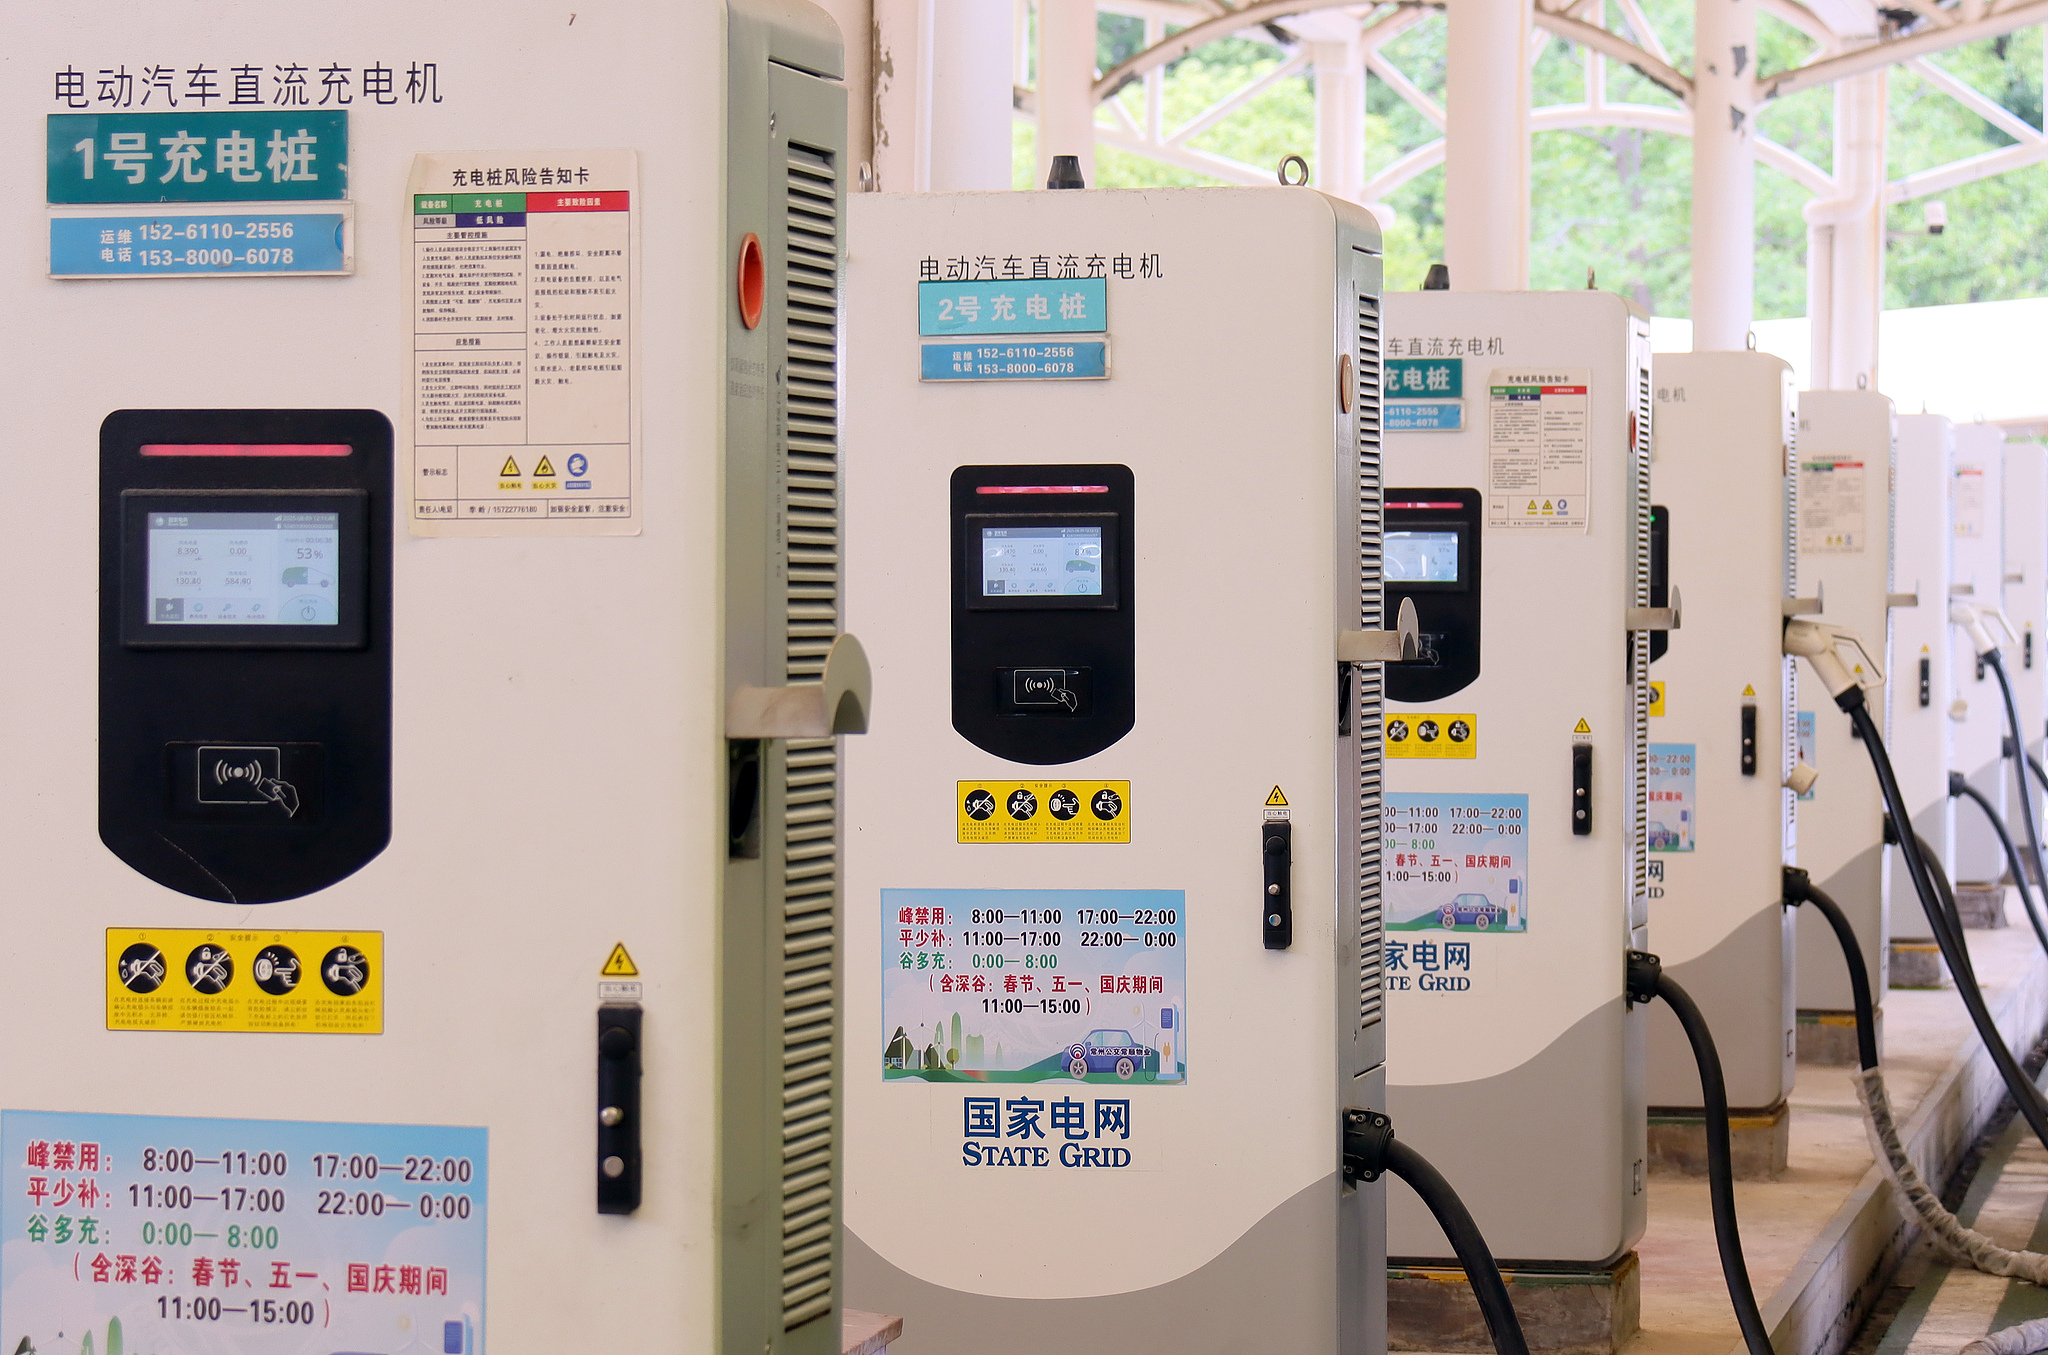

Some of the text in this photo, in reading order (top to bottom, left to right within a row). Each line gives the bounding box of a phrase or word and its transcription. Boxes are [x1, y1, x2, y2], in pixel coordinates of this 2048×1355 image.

[53, 61, 443, 107] 电动汽车直流充电机
[74, 130, 318, 184] 1号充电桩
[452, 167, 590, 187] 充电桩风险告知卡
[475, 199, 503, 208] 充电桩
[476, 215, 504, 225] 低风险
[100, 221, 294, 245] 运维 152-6110-2556
[100, 247, 294, 267] 电话 153-8000-6078
[919, 253, 1163, 280] 电动汽车直流充电机
[938, 292, 1087, 322] 2号充电桩
[952, 347, 1074, 361] 运维 152-6110-2556
[1387, 337, 1505, 356] 车直流充电机
[953, 362, 1074, 374] 电话 153-8000-6078
[1384, 366, 1451, 391] 充电桩
[1450, 807, 1522, 819] 17:00—22:00
[899, 906, 1177, 926] 峰禁用： 8:00—11:00 17:00—22:00
[899, 929, 953, 948] 平少补：
[962, 931, 1062, 947] 11:00—17:00
[899, 951, 953, 970] 谷多充：
[1385, 939, 1471, 971] 家电网
[1385, 973, 1471, 992] TE GRID
[963, 1096, 1131, 1140] 国家电网
[27, 1140, 472, 1183] 峰禁用： 8:00—11:00 17:00—22:00
[963, 1141, 1131, 1167] STATE GRID
[27, 1177, 113, 1209] 平少补：
[128, 1184, 285, 1213] 11:00—17:00
[27, 1214, 112, 1245] 谷多充：
